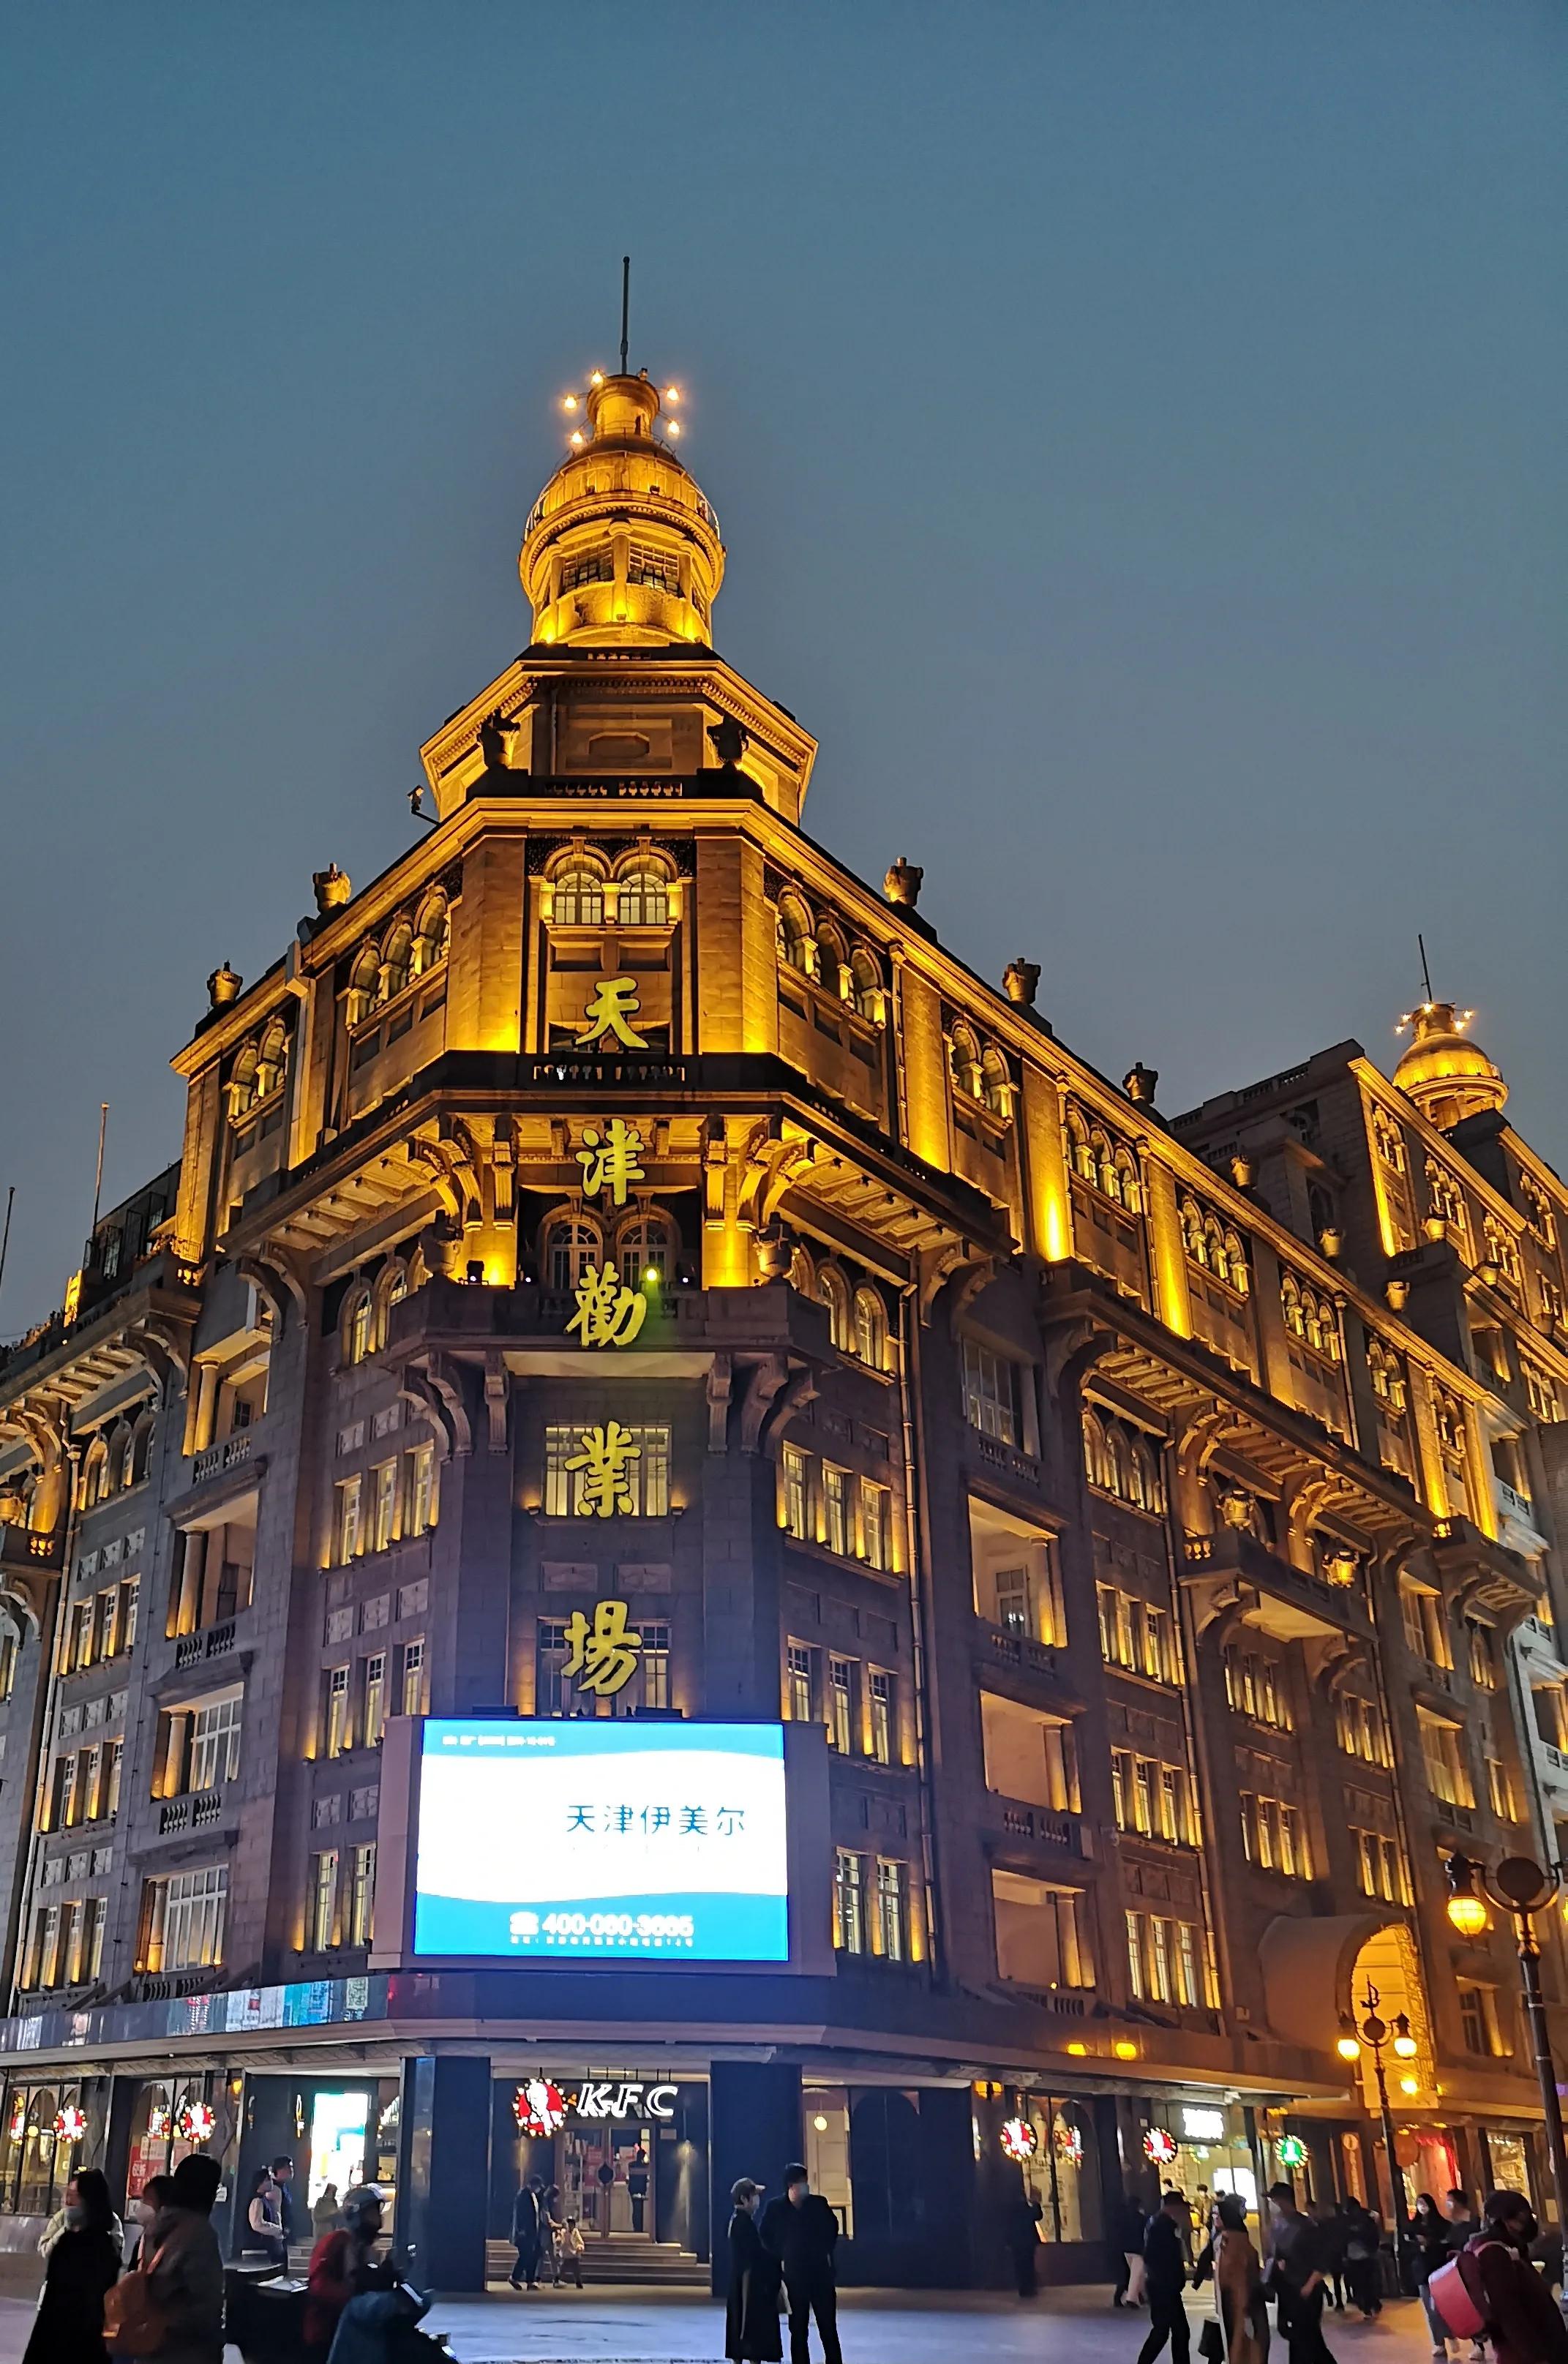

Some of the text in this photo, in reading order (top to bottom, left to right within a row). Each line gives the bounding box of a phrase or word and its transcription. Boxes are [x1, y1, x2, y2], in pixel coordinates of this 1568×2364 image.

[560, 977, 650, 1695] 天津勸業場
[566, 1804, 745, 1836] 天津伊美尔
[577, 2083, 678, 2117] KFC
